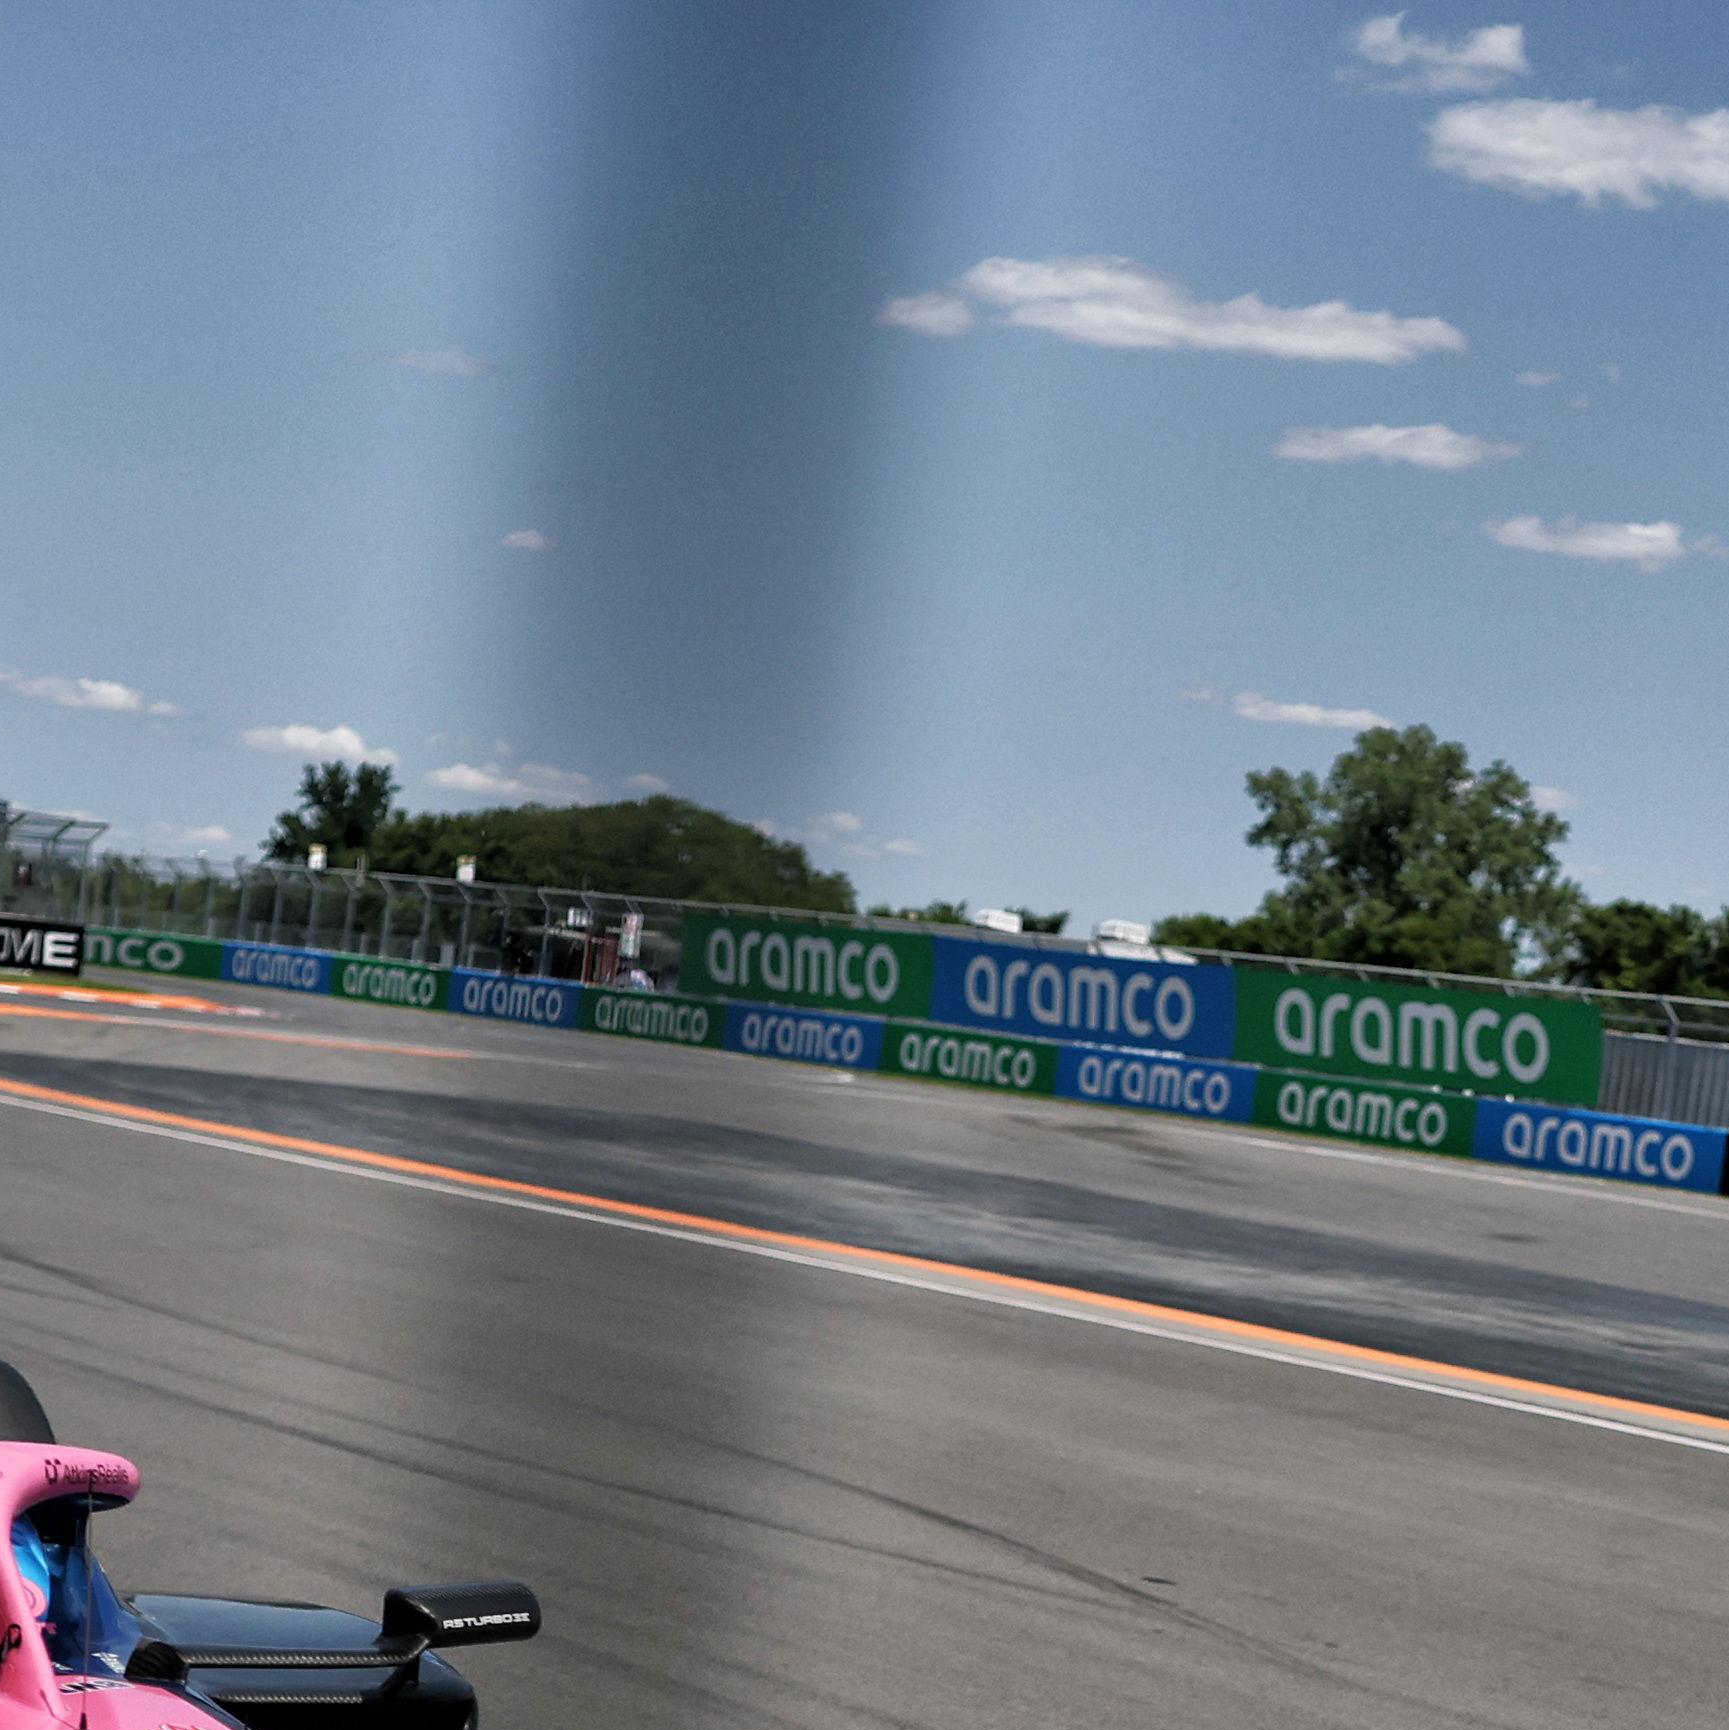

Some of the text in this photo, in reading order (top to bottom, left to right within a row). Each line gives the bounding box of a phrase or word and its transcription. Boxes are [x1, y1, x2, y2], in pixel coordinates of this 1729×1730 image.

[231, 949, 321, 989] aramco
[341, 959, 438, 1006] aramco
[706, 928, 900, 1002] aramco
[462, 970, 563, 1023] aramco
[594, 991, 709, 1044] aramco
[964, 953, 1196, 1041] aramco
[740, 1012, 864, 1063] aramco
[899, 1032, 1037, 1089] aramco
[1274, 987, 1551, 1084] aramco
[1078, 1056, 1231, 1113] aramco
[1277, 1081, 1448, 1146] aramco
[1502, 1111, 1695, 1181] aramco
